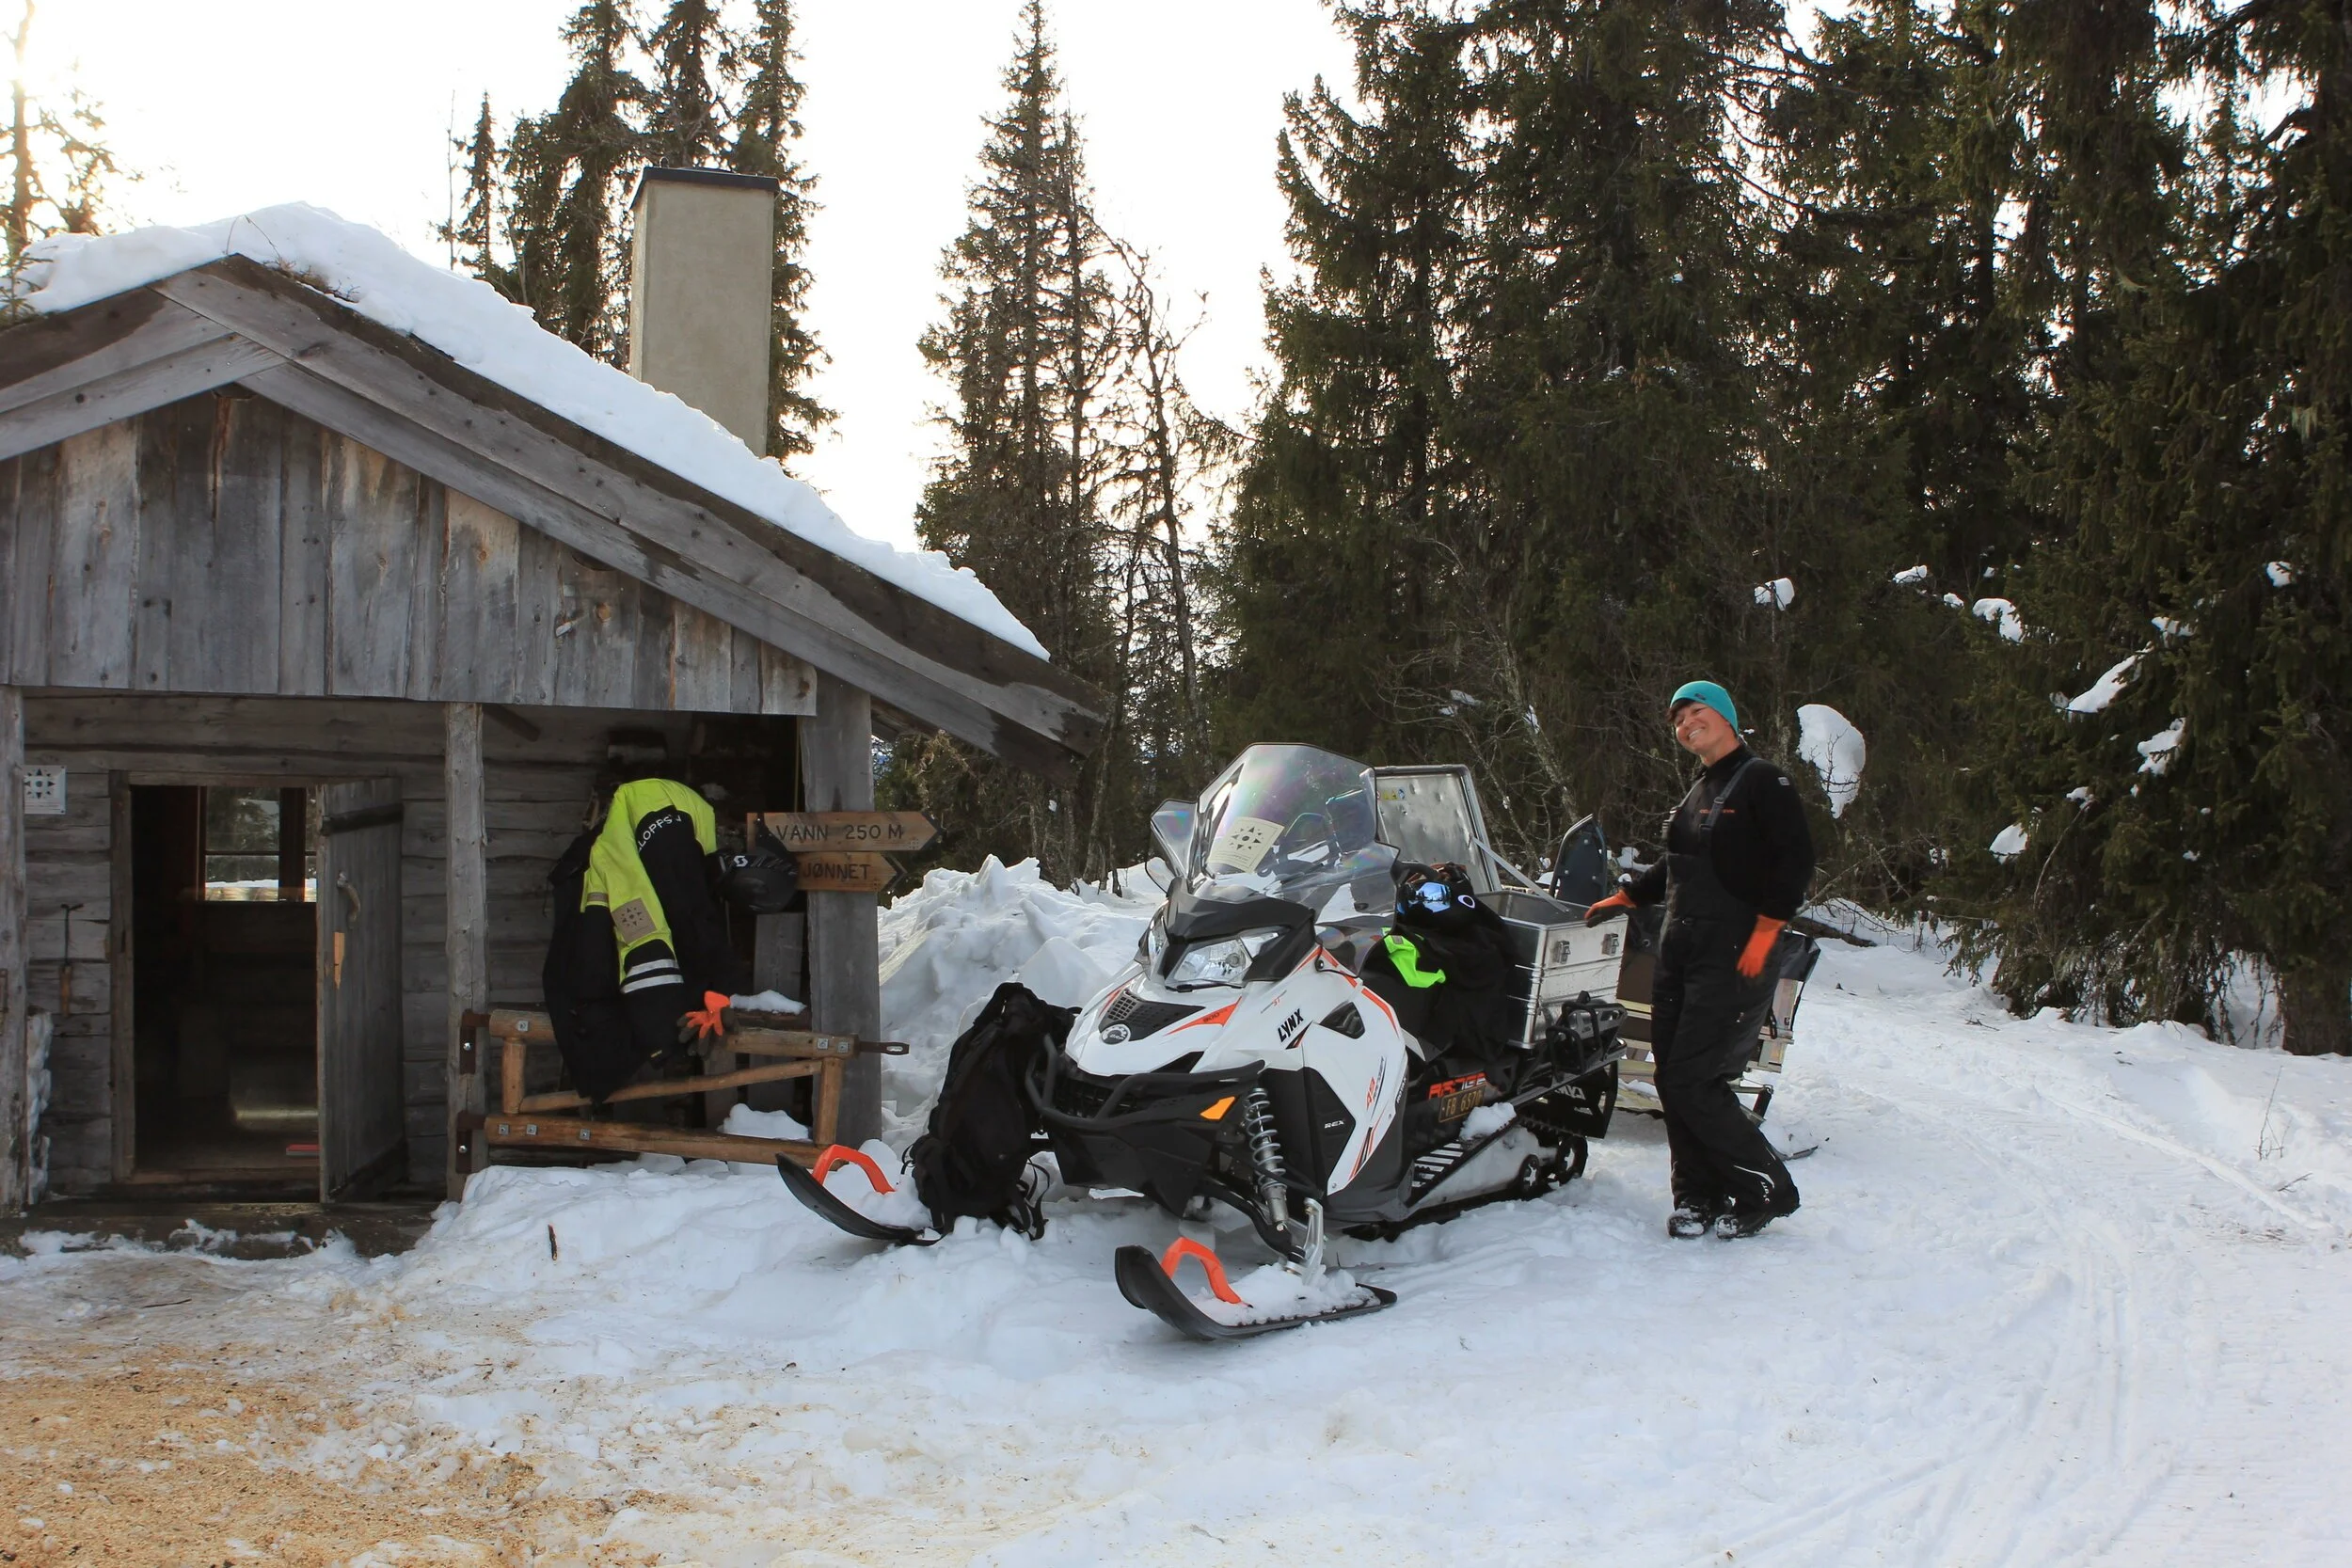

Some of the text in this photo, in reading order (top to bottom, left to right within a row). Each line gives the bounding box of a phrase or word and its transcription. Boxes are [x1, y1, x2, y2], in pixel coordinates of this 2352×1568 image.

[776, 824, 904, 841] VANN 250 M
[803, 862, 871, 881] JØNNET
[1278, 1007, 1304, 1042] LYNX
[1324, 1120, 1345, 1129] REX
